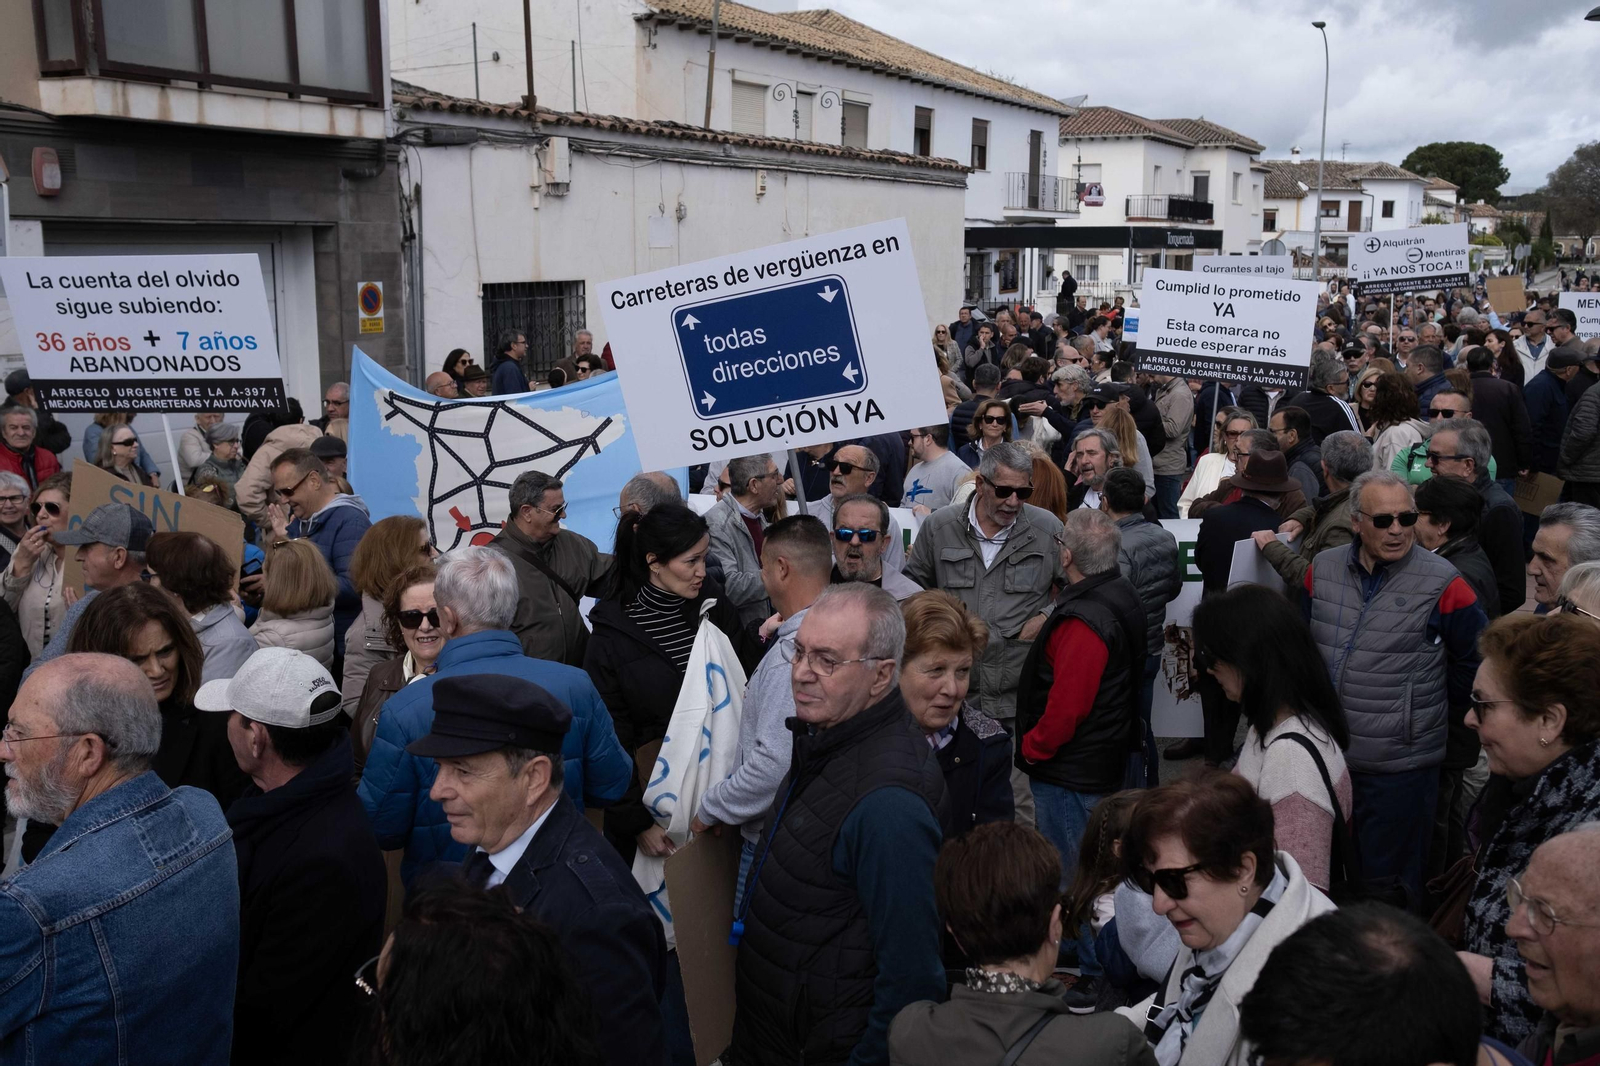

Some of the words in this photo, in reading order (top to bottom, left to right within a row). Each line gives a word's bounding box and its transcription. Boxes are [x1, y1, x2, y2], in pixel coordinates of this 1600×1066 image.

[1167, 232, 1194, 247] Torquemada
[1383, 238, 1425, 248] Alquitrán
[1426, 248, 1466, 258] Mentiras
[610, 272, 719, 310] Carreteras
[723, 264, 750, 286] de
[753, 242, 867, 282] vergüenza
[872, 236, 900, 255] en
[1202, 264, 1252, 274] Currantes
[1254, 265, 1264, 274] al
[1266, 265, 1285, 275] tajo
[1373, 267, 1388, 276] YA
[1391, 265, 1416, 275] NOS
[1419, 261, 1452, 272] TOCA
[26, 272, 53, 289] La
[59, 272, 132, 289] cuenta
[137, 270, 170, 288] del
[175, 269, 240, 287] olvido
[1156, 279, 1210, 296] Cumplid
[1214, 284, 1226, 296] lo
[1229, 286, 1301, 302] prometido
[56, 299, 112, 319] sigue
[119, 297, 223, 314] subiendo:
[1213, 302, 1235, 318] YA
[1167, 318, 1195, 332] Esta
[1199, 323, 1258, 338] comarca
[1262, 330, 1280, 340] no
[36, 333, 66, 352] 36
[72, 332, 131, 351] años
[144, 330, 161, 348] +
[176, 331, 190, 350] 7
[198, 331, 258, 350] años
[703, 327, 768, 355] todas
[1156, 335, 1197, 349] puede
[1201, 340, 1254, 355] esperar
[1258, 344, 1287, 358] más
[69, 355, 242, 373] ABANDONADOS
[712, 344, 841, 384] direcciones
[1146, 356, 1186, 366] ARREGLO
[1190, 361, 1232, 372] URGENTE
[1269, 369, 1295, 378] A-397
[1198, 370, 1246, 381] CARRETERAS
[1254, 376, 1286, 386] AUTOVÍA
[51, 388, 110, 397] ARREGLO
[117, 388, 178, 397] URGENTE
[185, 388, 201, 397] DE
[208, 388, 224, 396] LA
[231, 387, 266, 396] A-397
[93, 400, 108, 408] DE
[110, 399, 130, 408] LAS
[132, 399, 202, 408] CARRETERAS
[203, 399, 210, 408] Y
[213, 397, 259, 408] AUTOVÍA
[690, 405, 839, 452] SOLUCIÓN
[845, 398, 886, 426] YA
